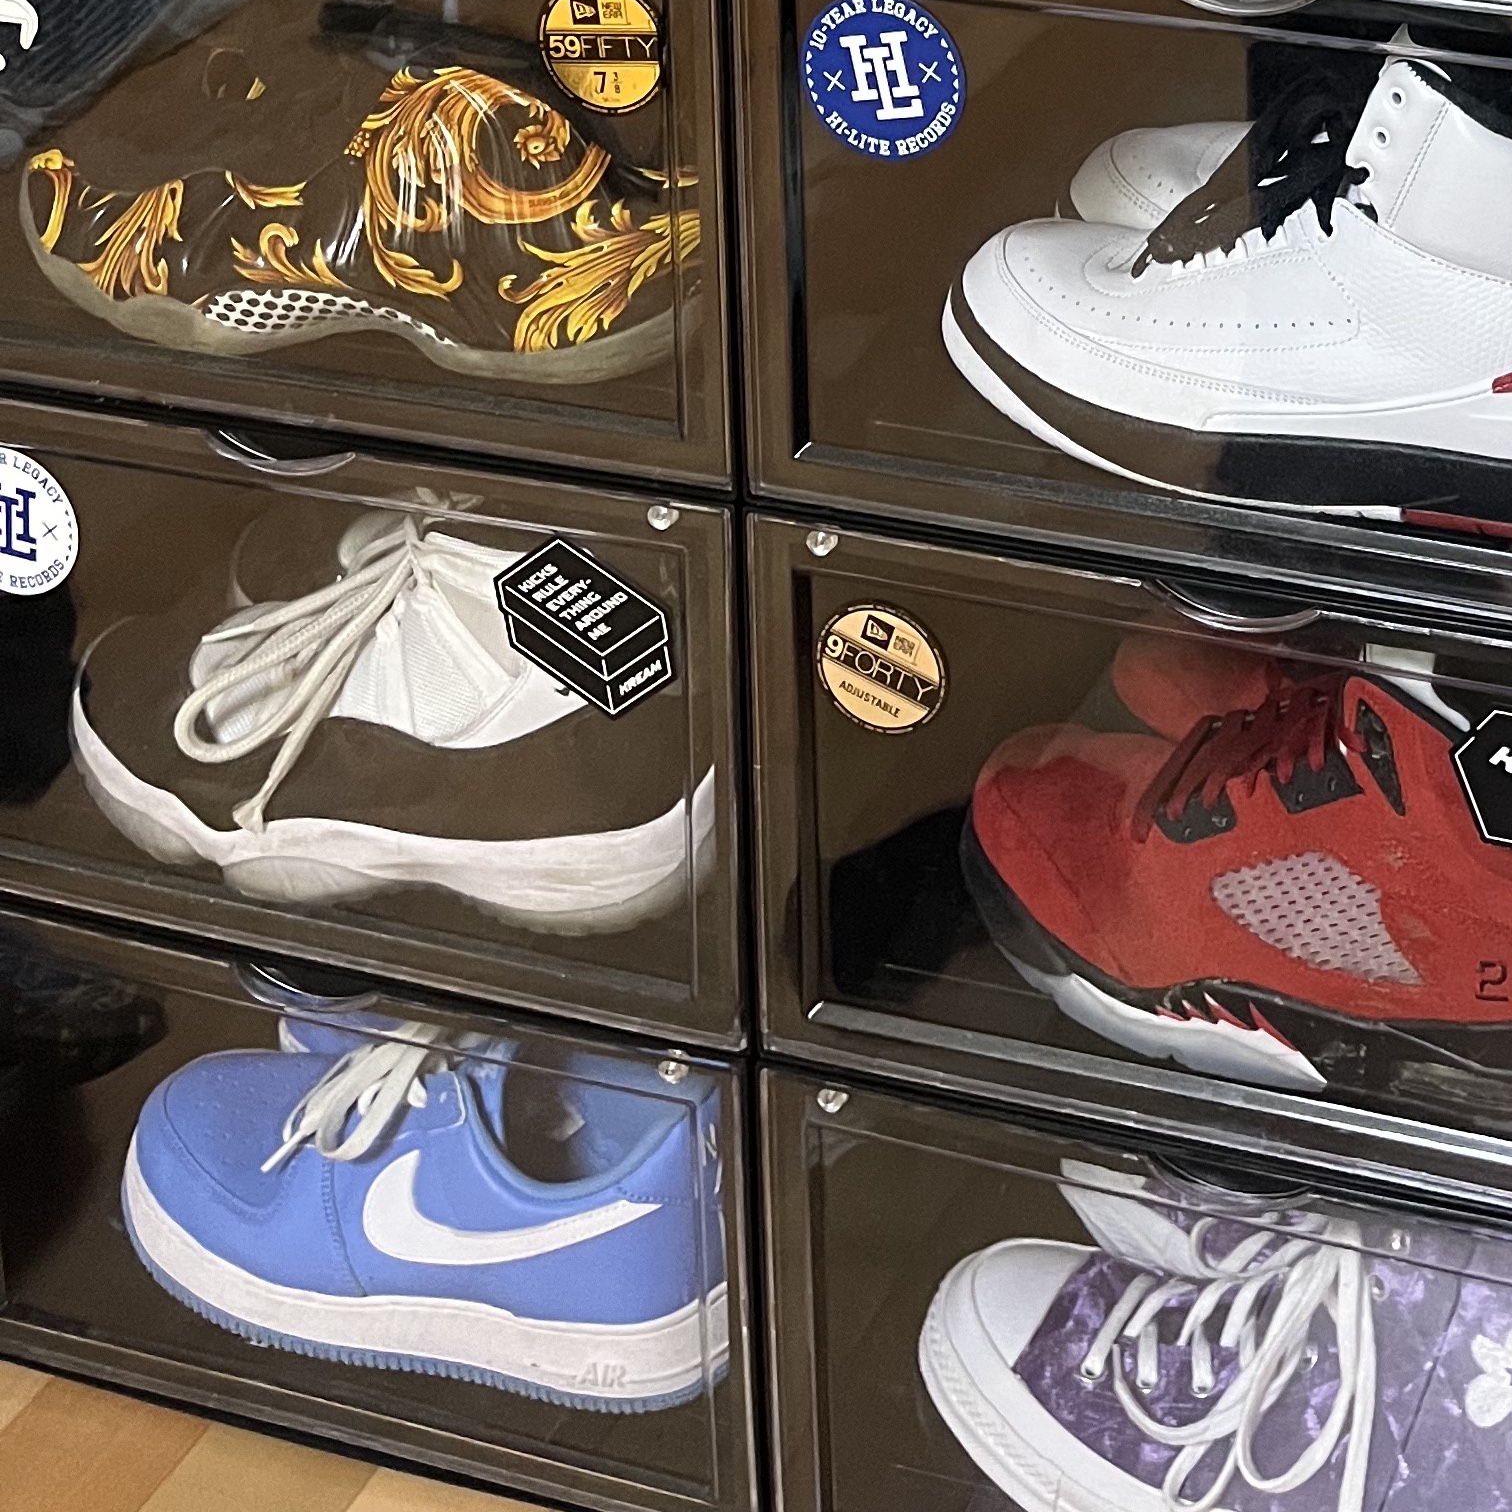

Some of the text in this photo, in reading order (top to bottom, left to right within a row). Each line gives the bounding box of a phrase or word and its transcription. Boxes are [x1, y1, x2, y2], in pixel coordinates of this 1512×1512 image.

[549, 35, 659, 59] 59FIFTY
[826, 101, 956, 156] HI-LITE RECORDS
[13, 456, 64, 504] LEGACY
[9, 558, 65, 589] RECORDS
[518, 563, 559, 593] KICKS
[532, 575, 570, 603] RULE
[559, 591, 602, 620] THING
[575, 591, 629, 632] AROUND
[587, 622, 612, 641] ME
[619, 659, 662, 696] KREAM
[824, 634, 935, 701] 9FORTY
[839, 680, 901, 718] ADJUSTABLE
[578, 1361, 627, 1388] AIR
